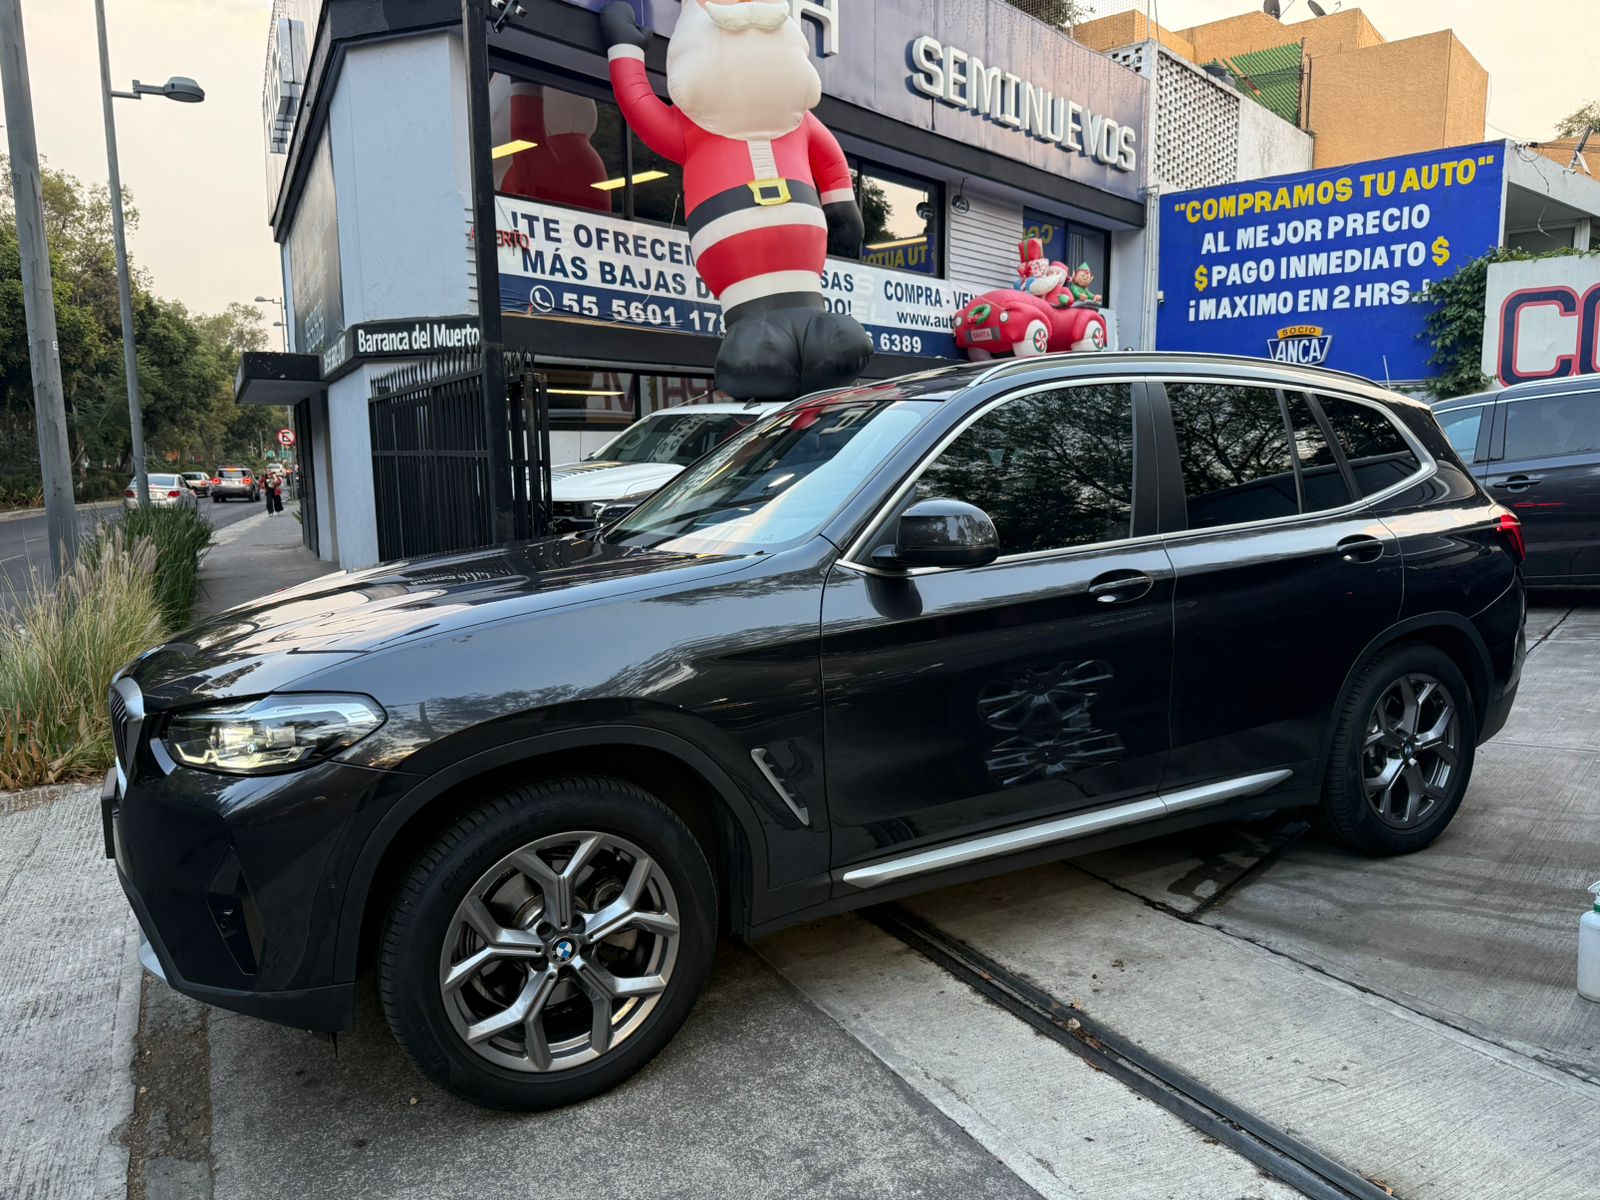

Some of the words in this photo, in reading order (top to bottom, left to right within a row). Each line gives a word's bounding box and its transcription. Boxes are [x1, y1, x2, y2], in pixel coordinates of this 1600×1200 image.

[912, 35, 1136, 172] SEMINUEVOS
[1174, 177, 1353, 223] "COMPRAMOS
[1360, 170, 1396, 198] TU
[1400, 155, 1494, 193] AUTO"
[1201, 231, 1230, 255] AL
[1236, 218, 1322, 250] MEJOR
[1327, 203, 1431, 240] PRECIO
[522, 247, 588, 281] MÁS
[599, 260, 687, 296] BAJAS
[1211, 258, 1275, 287] PAGO
[1280, 241, 1426, 280] INMEDIATO
[1431, 236, 1450, 266] $
[884, 280, 942, 308] COMPRA
[1298, 288, 1328, 313] EN
[1332, 285, 1351, 309] 2
[357, 328, 410, 352] Barranca
[412, 323, 431, 349] del
[433, 323, 480, 349] Muerto
[563, 292, 599, 316] 55
[612, 299, 677, 327] 5601
[880, 333, 922, 353] 6389
[1282, 326, 1316, 336] SOCIO
[1275, 338, 1321, 363] ANCA
